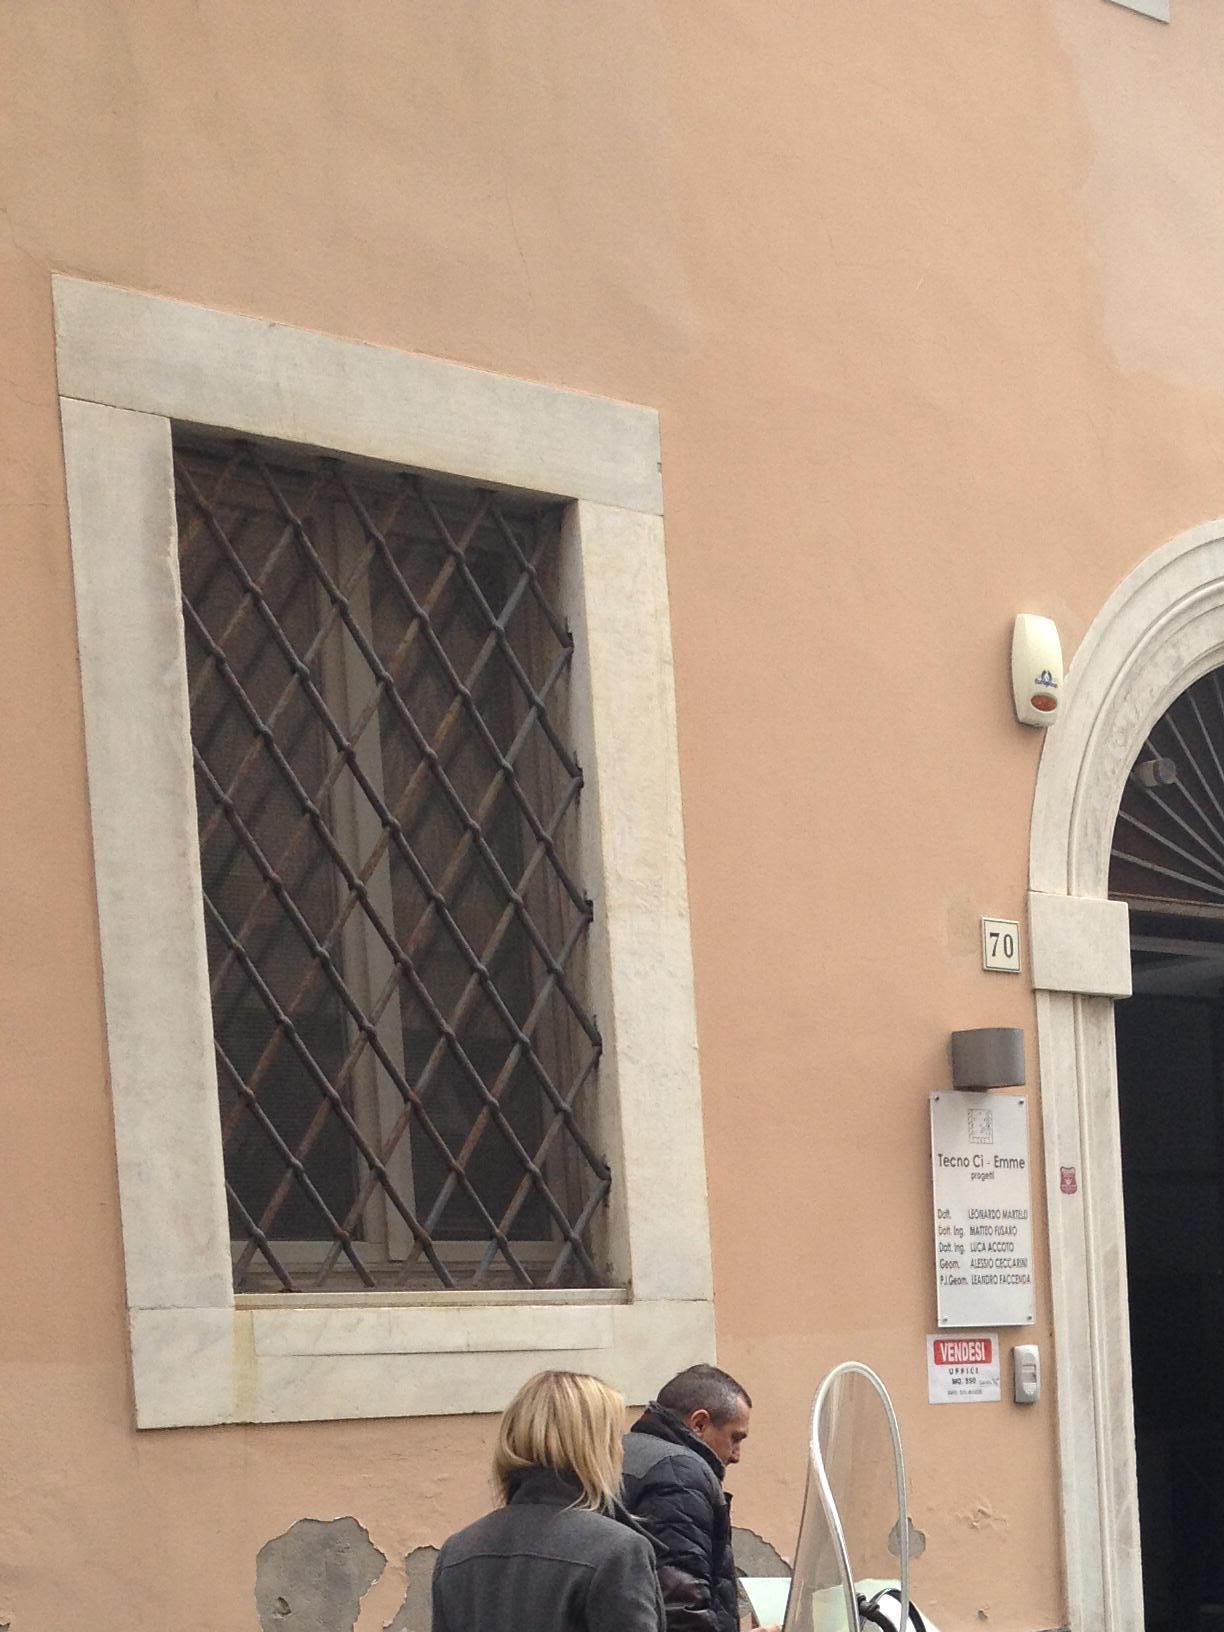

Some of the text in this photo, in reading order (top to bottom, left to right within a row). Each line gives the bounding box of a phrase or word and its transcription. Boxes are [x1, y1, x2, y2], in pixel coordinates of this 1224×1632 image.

[989, 932, 1014, 958] 70
[938, 1153, 970, 1168] Tecno
[994, 1155, 1026, 1169] Emme
[970, 1225, 993, 1236] MATTEO
[970, 1242, 987, 1253] LUCA
[970, 1258, 994, 1269] ALESSIO
[940, 1341, 986, 1362] VENDESI
[949, 1367, 979, 1376] UFFICI
